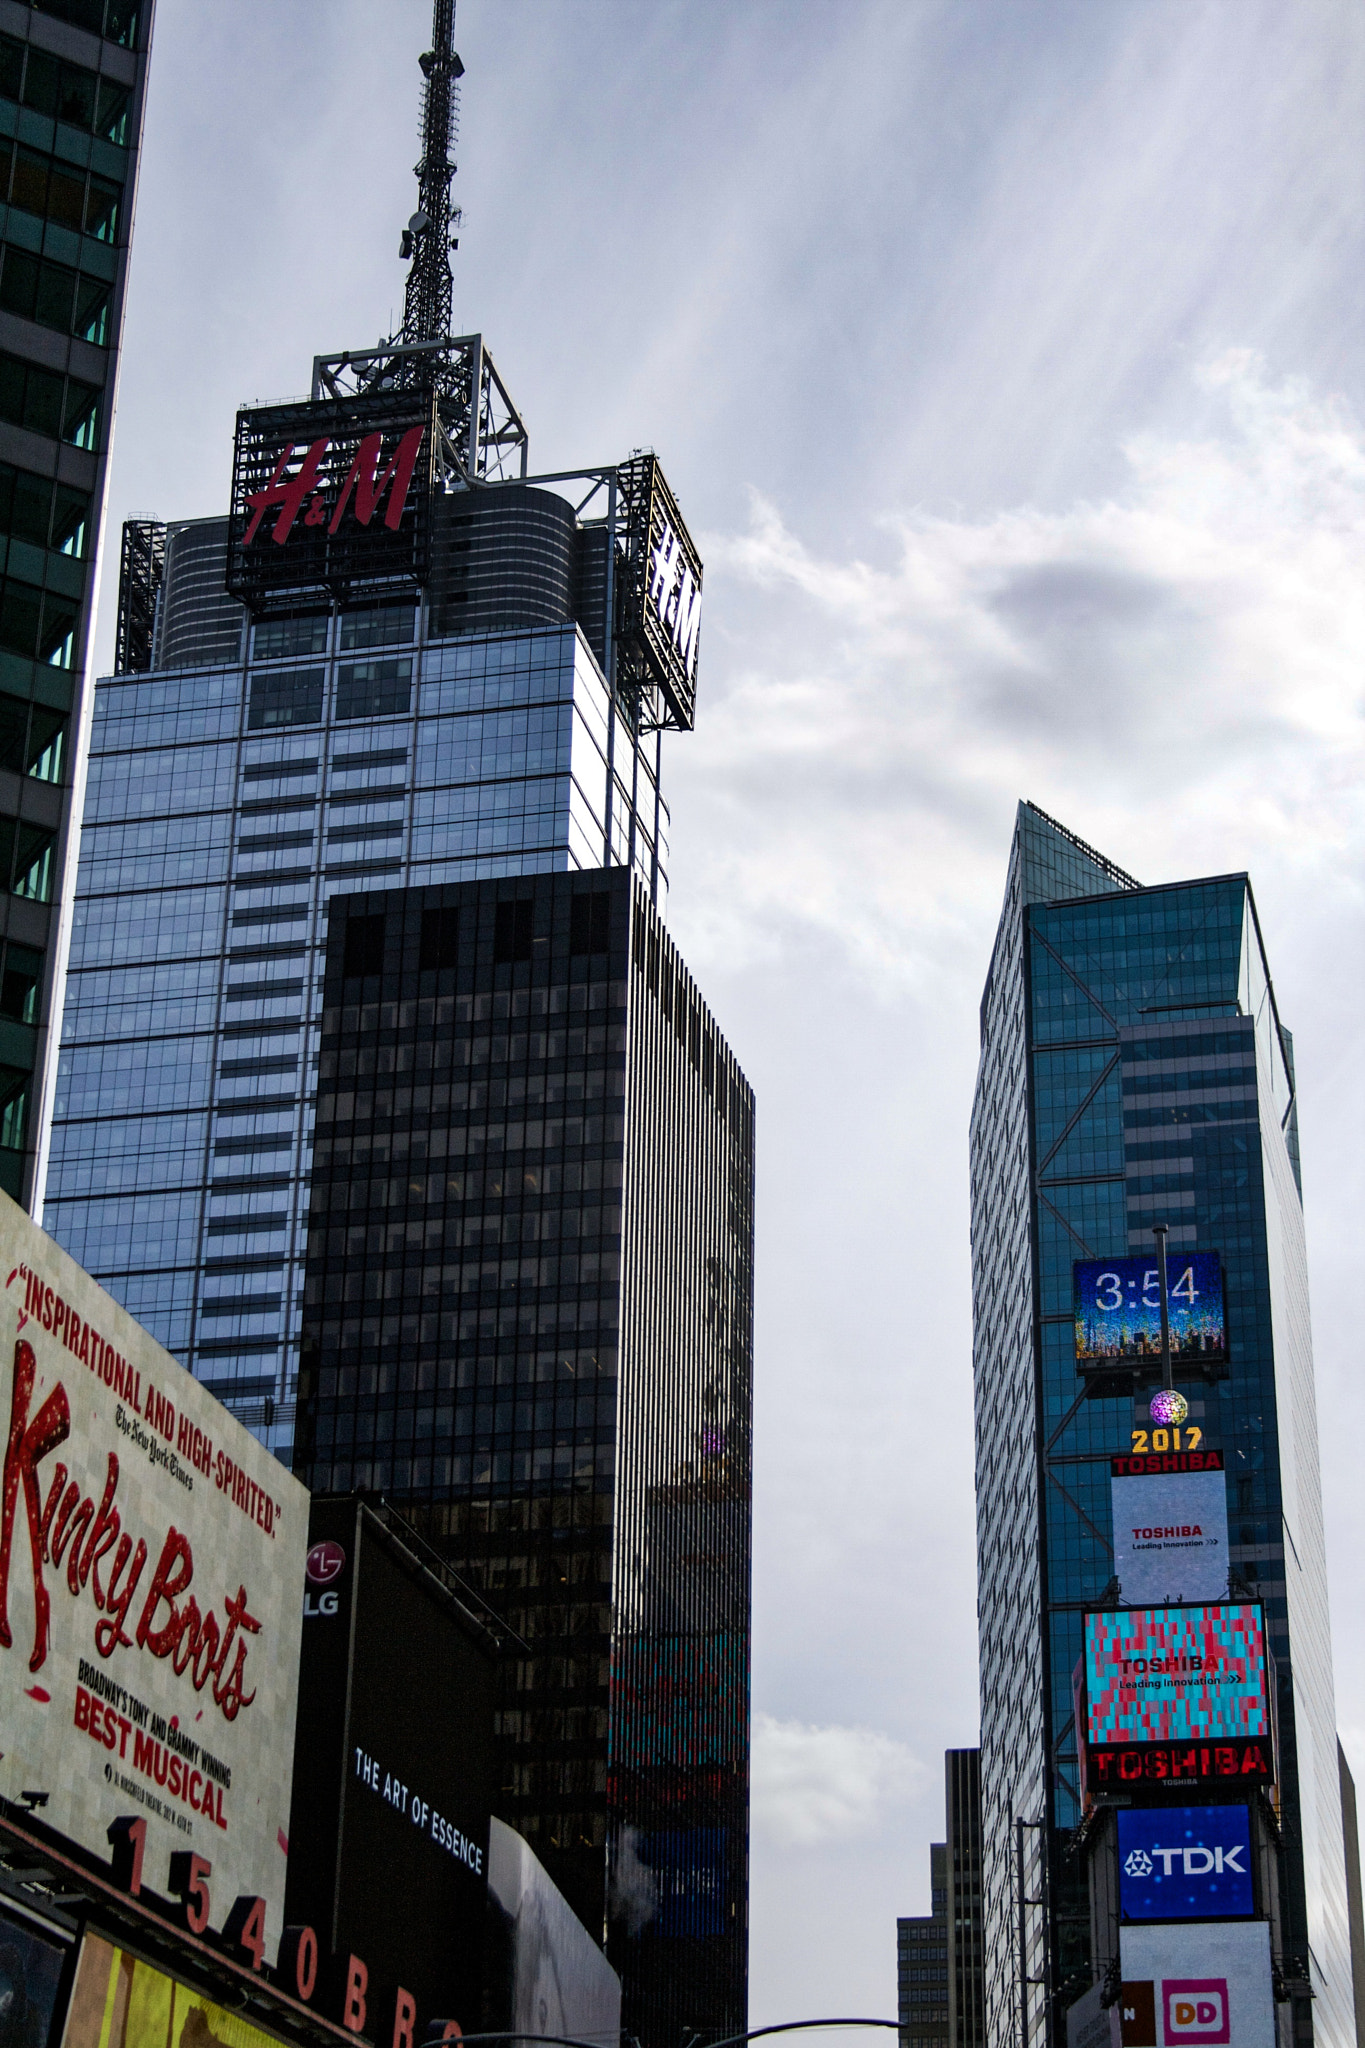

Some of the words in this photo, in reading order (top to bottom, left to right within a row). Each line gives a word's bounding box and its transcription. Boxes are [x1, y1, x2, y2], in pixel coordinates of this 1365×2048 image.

[242, 426, 425, 545] H&M
[652, 523, 702, 682] H&M
[1096, 1267, 1199, 1310] 3:54
[144, 1383, 175, 1442] AND
[116, 1403, 131, 1435] The
[131, 1418, 149, 1451] New
[149, 1434, 169, 1469] York
[170, 1452, 193, 1490] Times
[1131, 1427, 1203, 1453] 2017
[1113, 1452, 1221, 1475] TOSHIBA
[0, 1339, 148, 1672] Kinky
[137, 1526, 262, 1721] Boots
[1132, 1525, 1203, 1540] TOSHIBA
[1132, 1542, 1162, 1550] Leading
[1163, 1540, 1204, 1548] Innovation
[303, 1591, 339, 1615] LG
[1119, 1655, 1219, 1674] TOSHIBA
[1119, 1679, 1161, 1690] Leading
[1163, 1676, 1221, 1687] Innovation
[74, 1685, 132, 1759] BEST
[133, 1727, 227, 1831] MUSICAL
[128, 1696, 150, 1729] TONY
[151, 1712, 167, 1742] AND
[167, 1724, 201, 1765] GRAMMY
[201, 1748, 232, 1789] WINNING
[1090, 1746, 1268, 1780] TOSHIBA
[1162, 1778, 1198, 1786] TOSHIBA
[355, 1746, 380, 1792] THE
[383, 1772, 409, 1813] ART
[412, 1795, 429, 1828] OF
[431, 1810, 482, 1875] ESSENCE
[1152, 1845, 1247, 1876] TDK
[109, 1815, 318, 2000] 1540
[1175, 2001, 1217, 2025] DD
